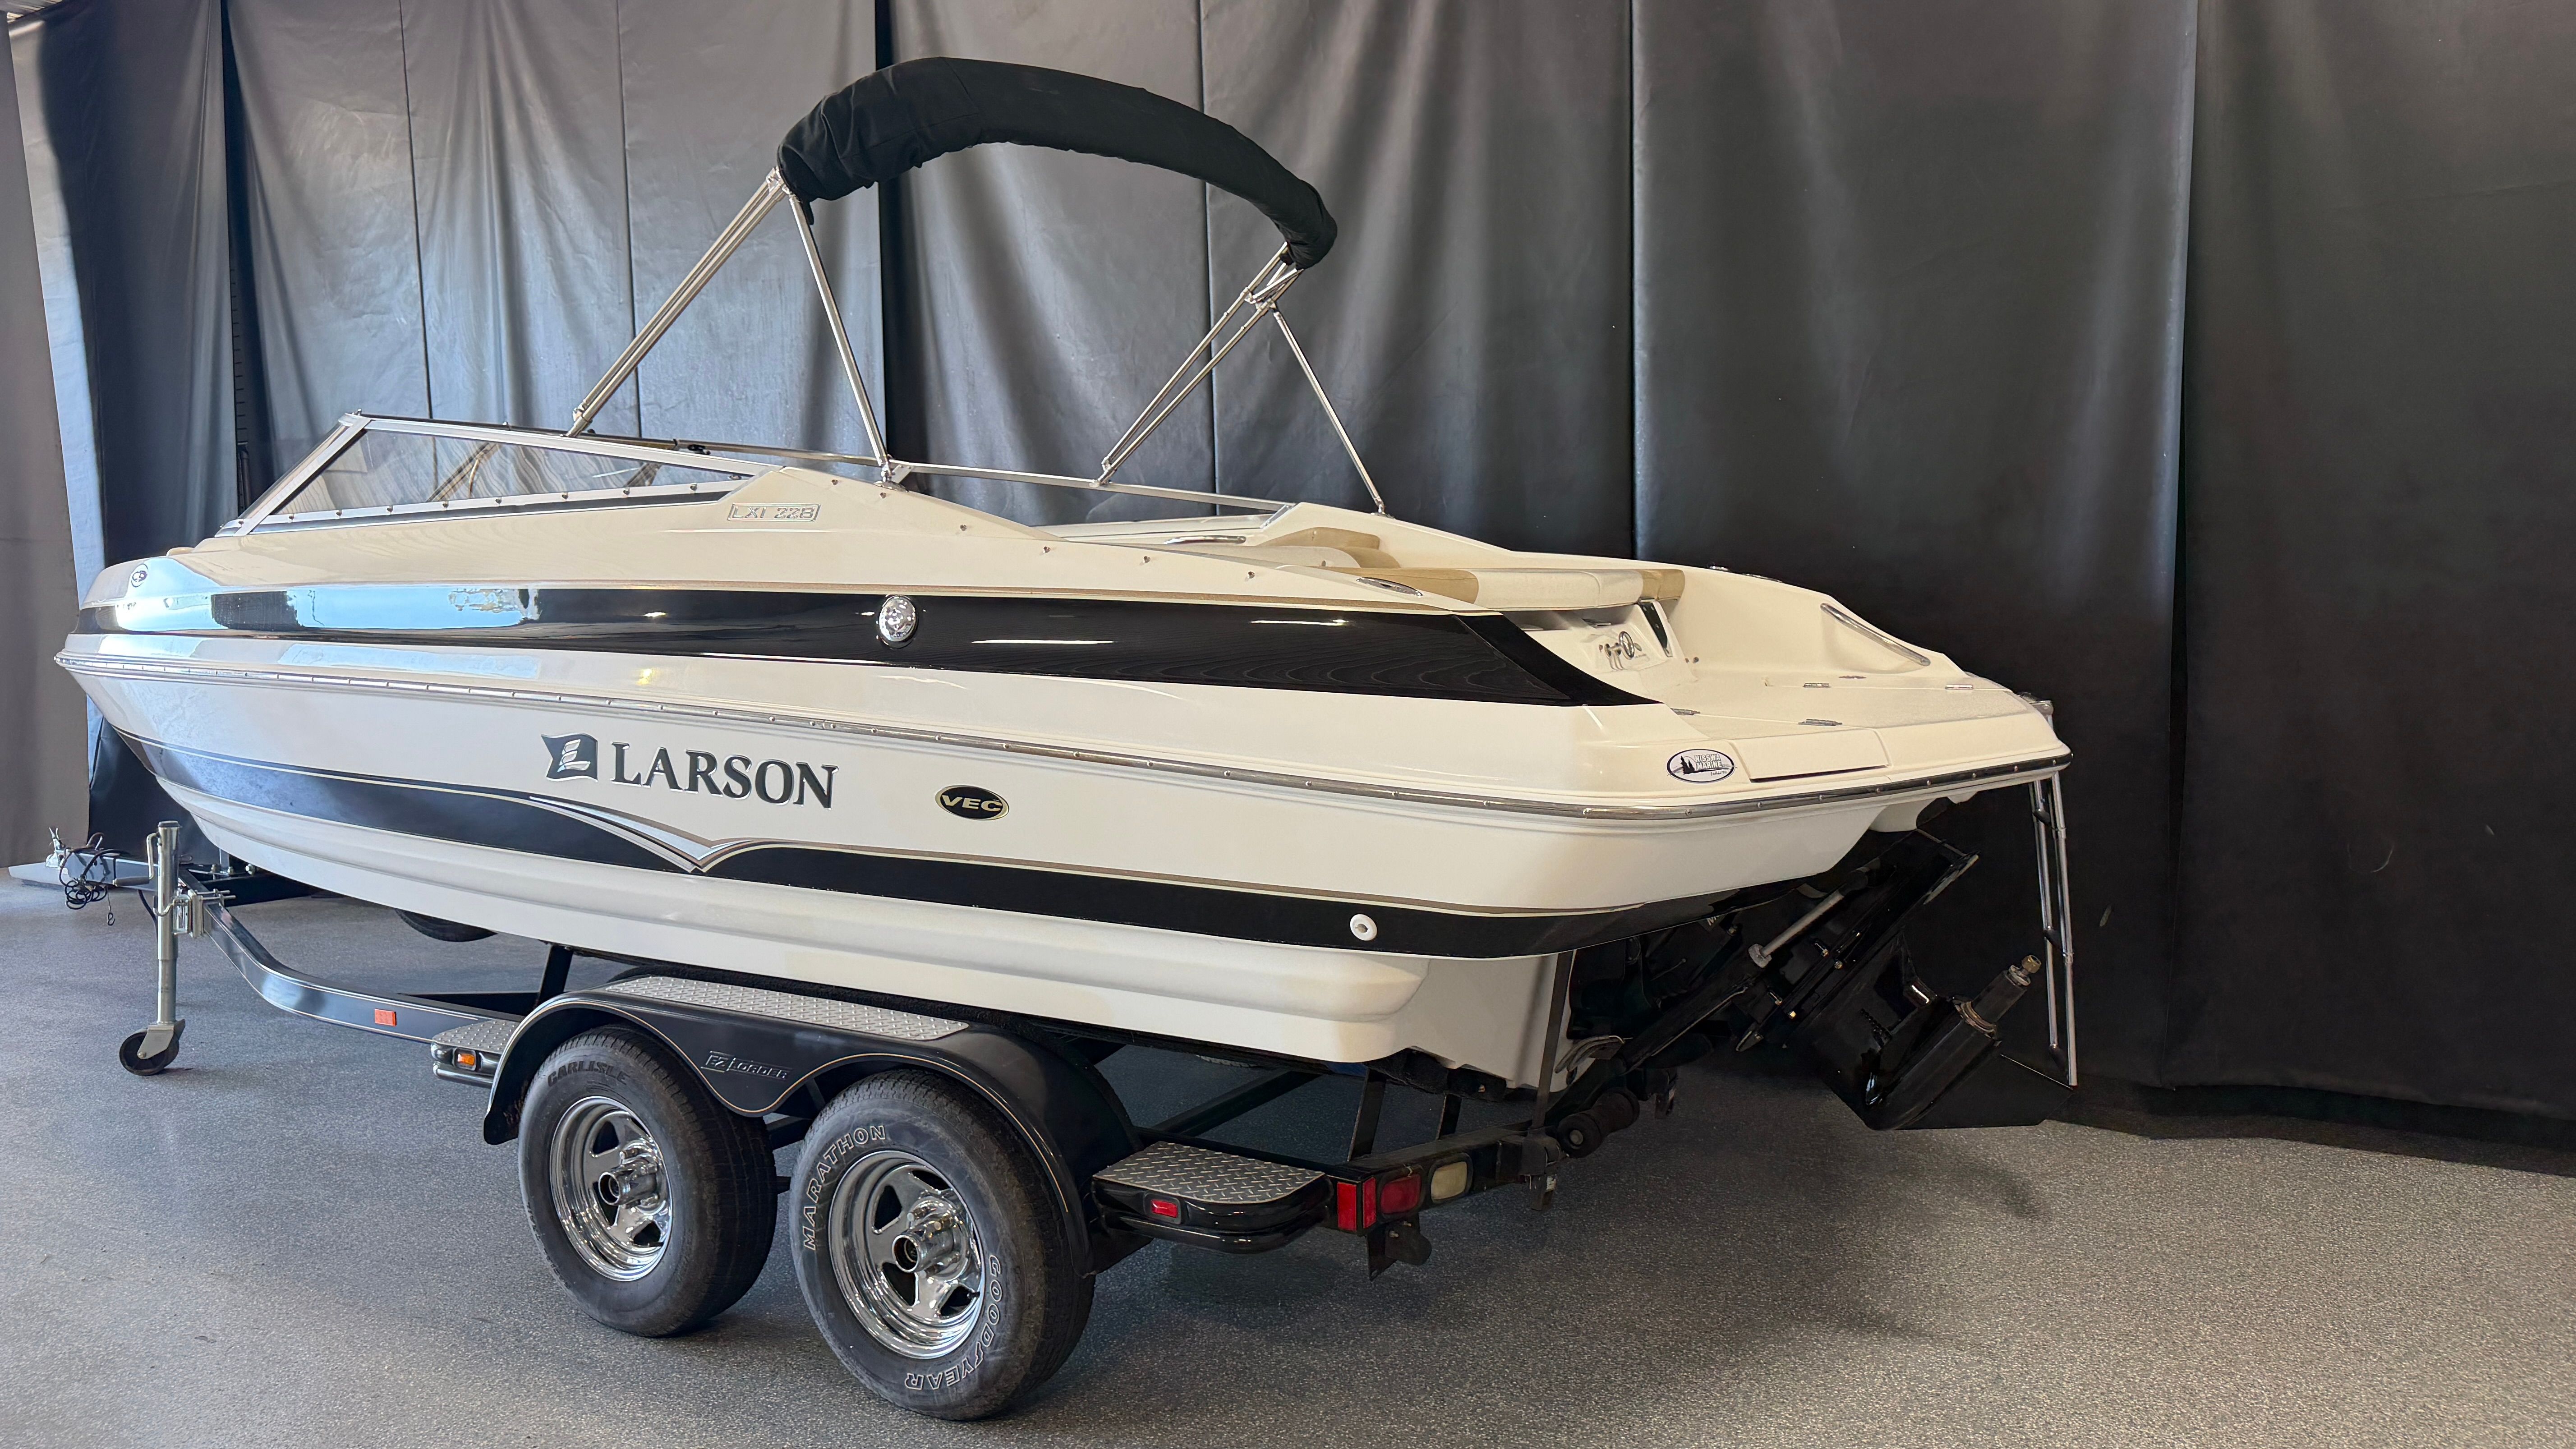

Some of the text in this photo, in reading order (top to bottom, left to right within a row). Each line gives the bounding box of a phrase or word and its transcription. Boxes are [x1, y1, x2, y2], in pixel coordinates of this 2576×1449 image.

[732, 506, 814, 519] LXI 228
[1694, 754, 1721, 763] NISSWA
[1696, 760, 1722, 770] MARINE
[611, 741, 839, 810] LARSON
[942, 795, 1003, 812] VEC
[547, 1060, 630, 1087] CARLISLE
[802, 1125, 886, 1251] MARATHON
[904, 1255, 1003, 1390] GOODYEAR
